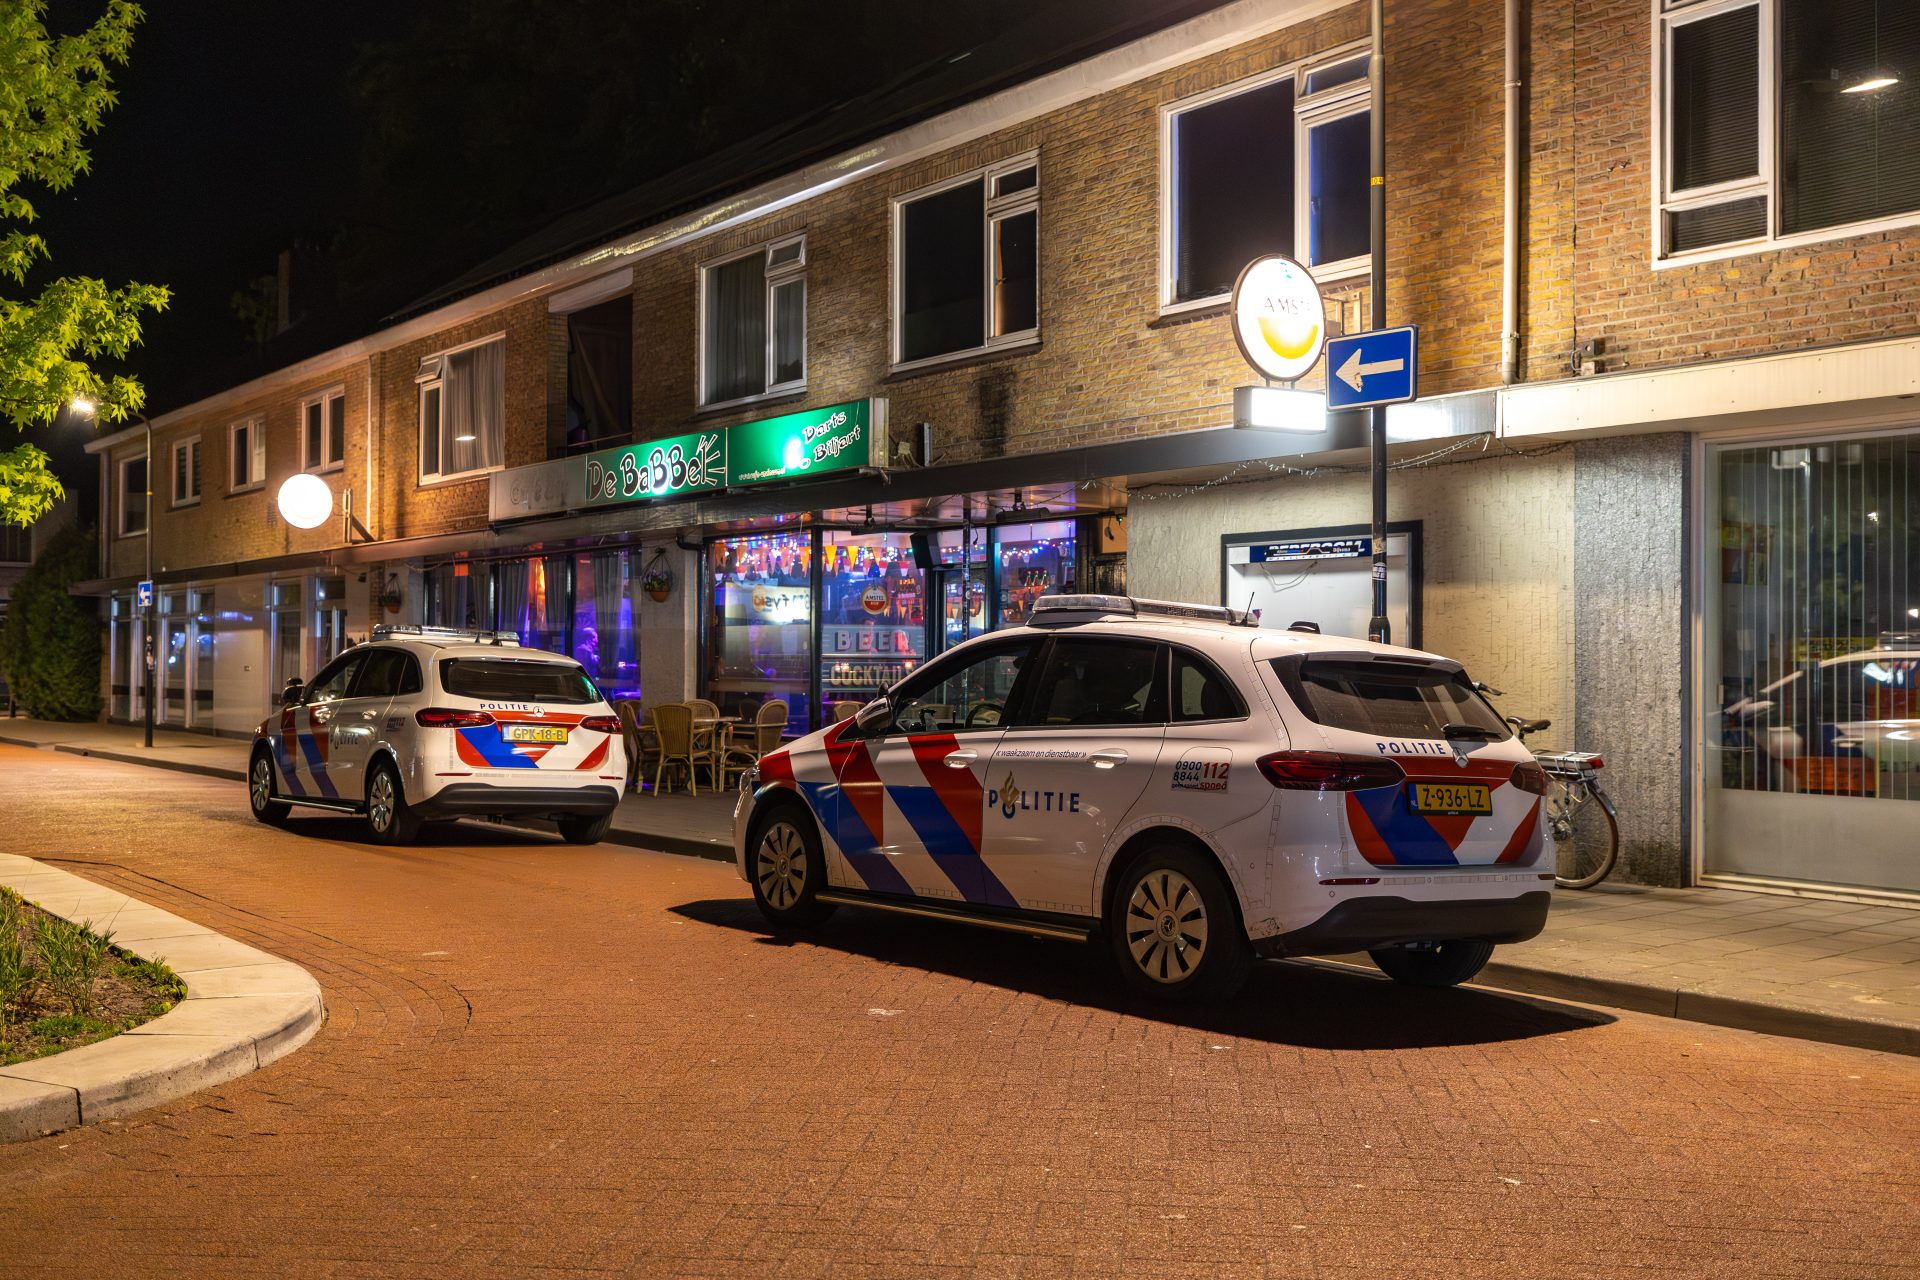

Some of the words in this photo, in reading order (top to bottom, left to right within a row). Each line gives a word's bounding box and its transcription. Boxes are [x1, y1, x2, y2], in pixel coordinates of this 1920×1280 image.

[802, 412, 847, 443] Darts
[813, 424, 861, 461] Biljart
[588, 460, 617, 501] De
[835, 630, 910, 652] BEER
[480, 703, 528, 711] POLITIE
[513, 728, 563, 740] GPK-18-B
[1001, 749, 1036, 757] waakzaam
[1045, 749, 1081, 758] dienstbaar
[1376, 742, 1446, 754] POLITIE
[1175, 760, 1202, 770] 0900
[1203, 761, 1230, 779] 112
[1173, 771, 1200, 781] 8844
[988, 789, 1080, 819] POLITIE
[1423, 786, 1485, 809] Z-936-LZ
